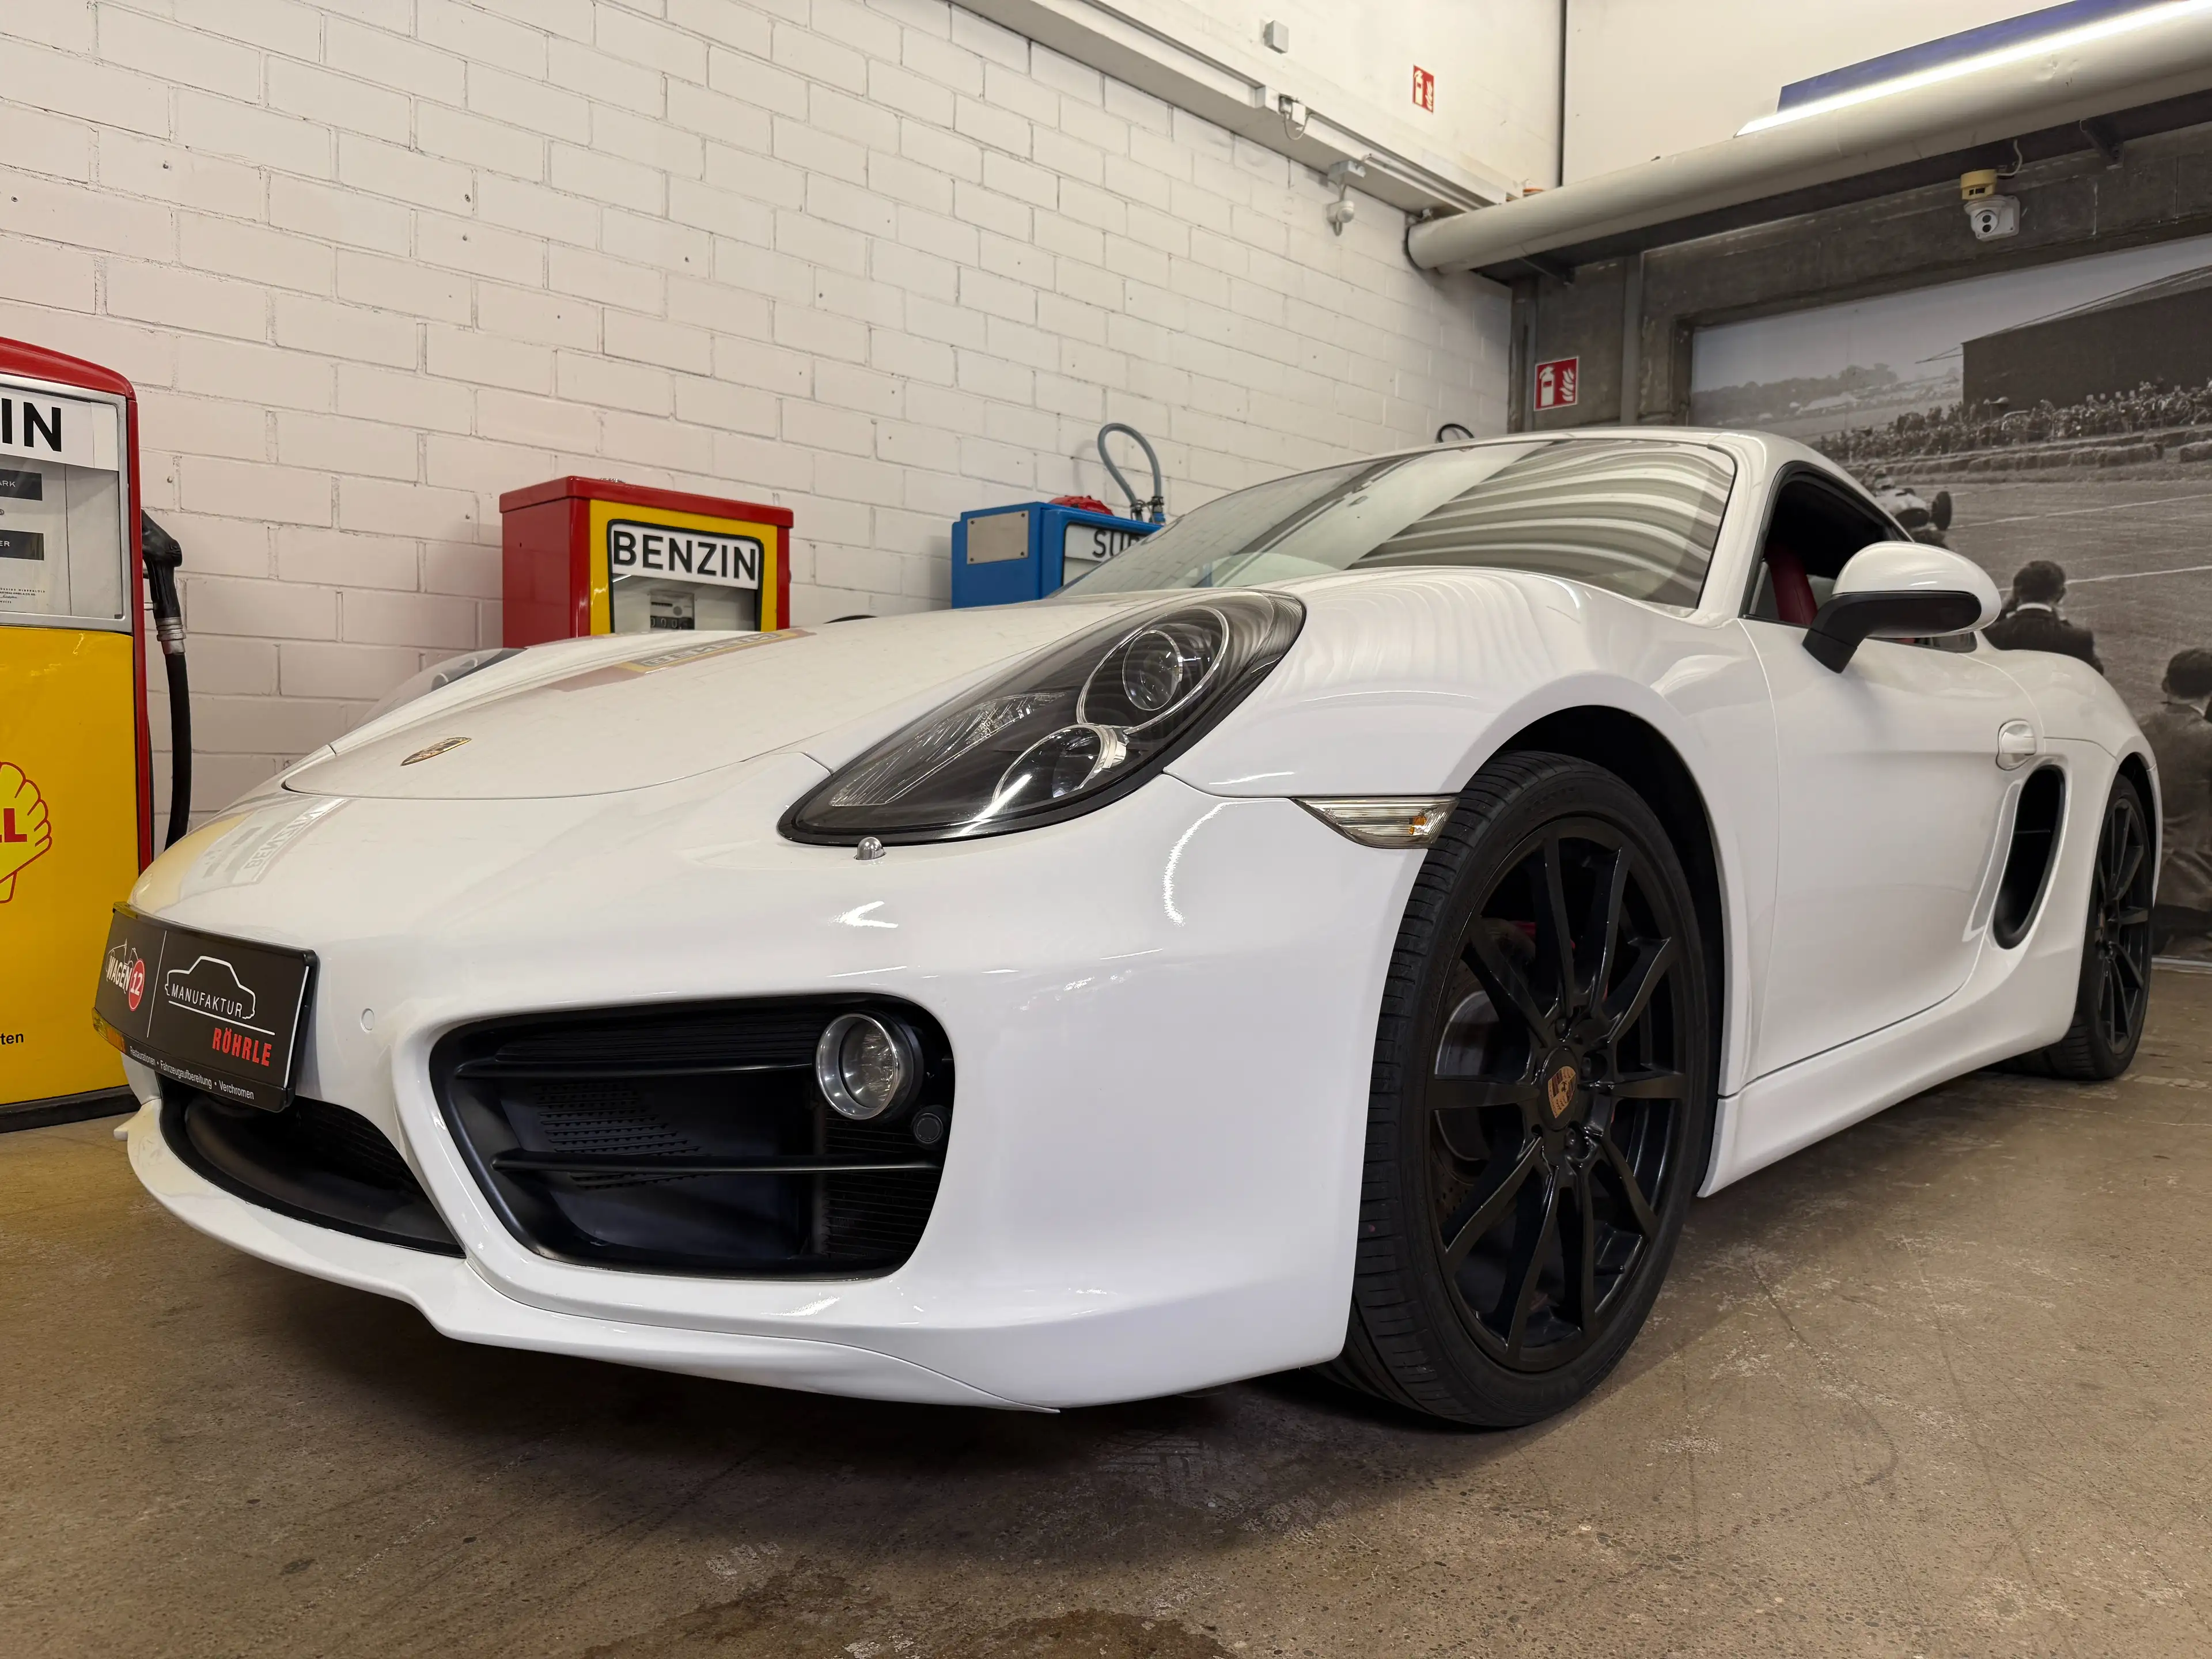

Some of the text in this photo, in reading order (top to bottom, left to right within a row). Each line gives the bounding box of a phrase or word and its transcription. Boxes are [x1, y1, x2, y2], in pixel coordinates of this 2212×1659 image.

[1, 397, 62, 452] IN
[613, 531, 756, 582] BENZIN
[107, 956, 143, 996] WAGEN 12
[171, 983, 243, 1018] MANUFAKTUR
[212, 1027, 272, 1067] RÖHRLE
[160, 1060, 212, 1089] Fahrzeugaufbereitung
[219, 1080, 254, 1100] Verchromen
